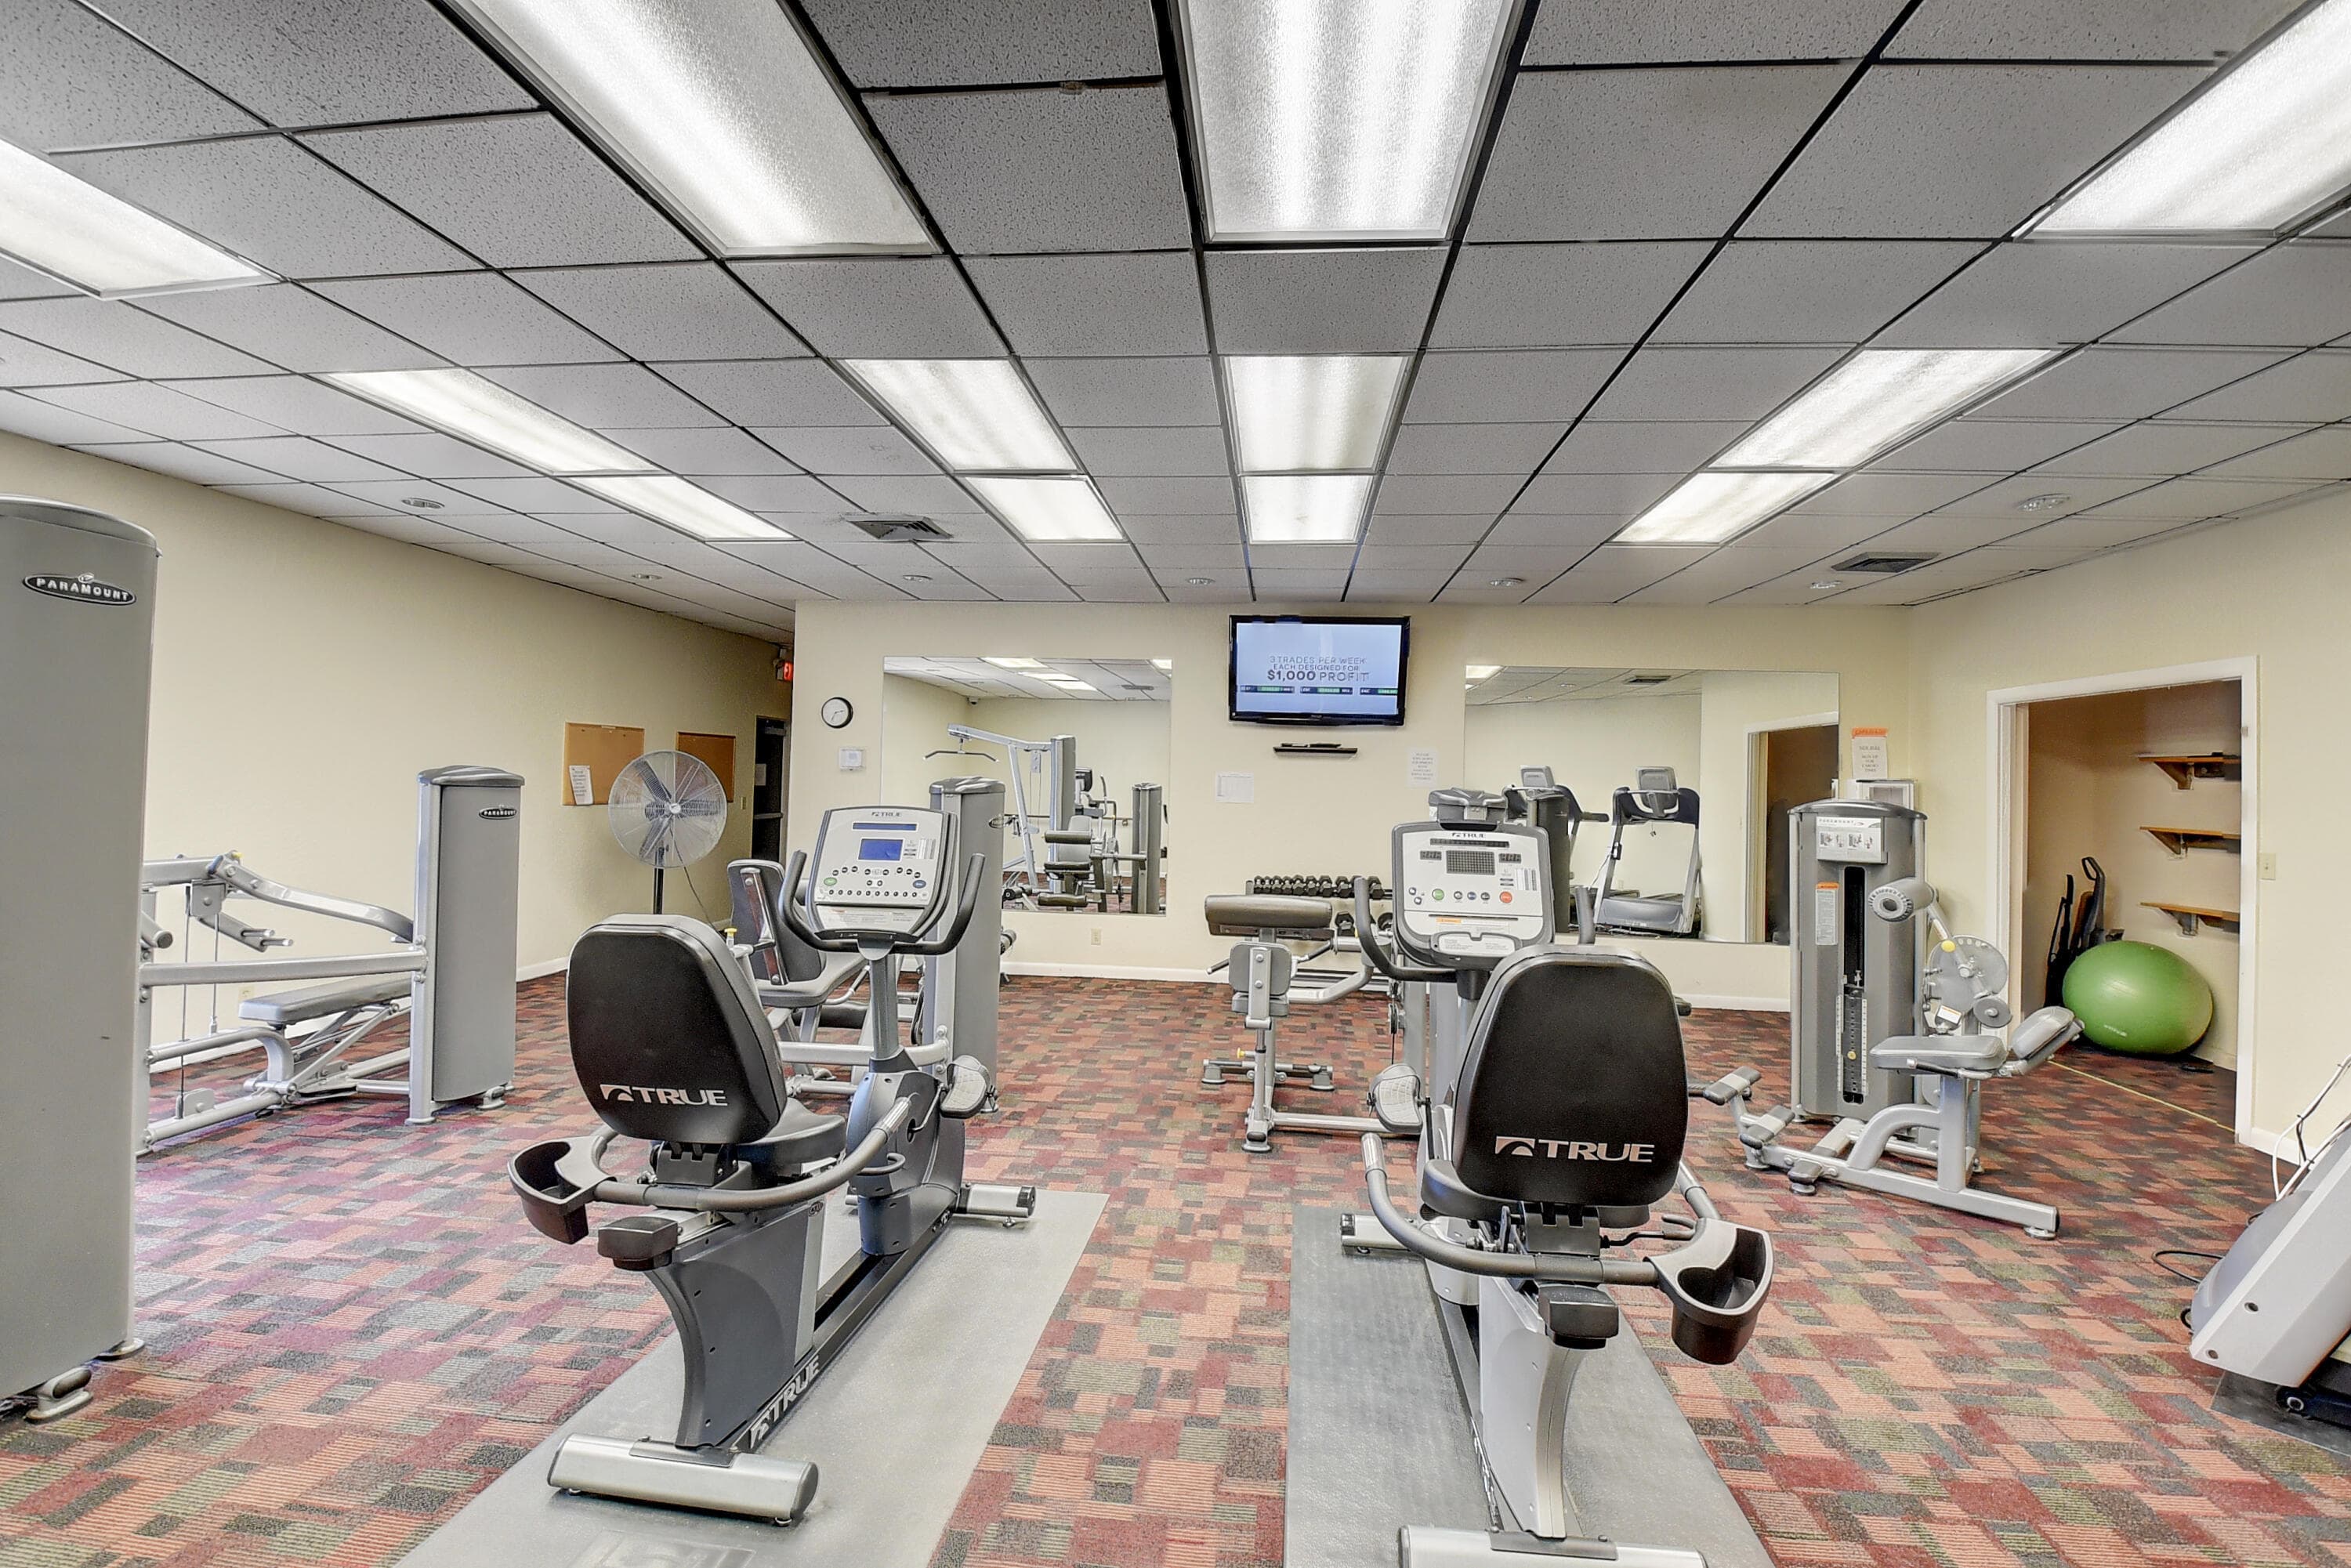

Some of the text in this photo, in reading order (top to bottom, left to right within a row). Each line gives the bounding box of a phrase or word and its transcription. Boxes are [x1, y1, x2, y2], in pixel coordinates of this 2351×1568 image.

[36, 578, 129, 601] PARAMOUNT
[1267, 669, 1369, 682] $1,000 PROFIT
[631, 1086, 728, 1106] TRUE
[1538, 1139, 1655, 1163] TRUE
[769, 1354, 820, 1422] TRUE
